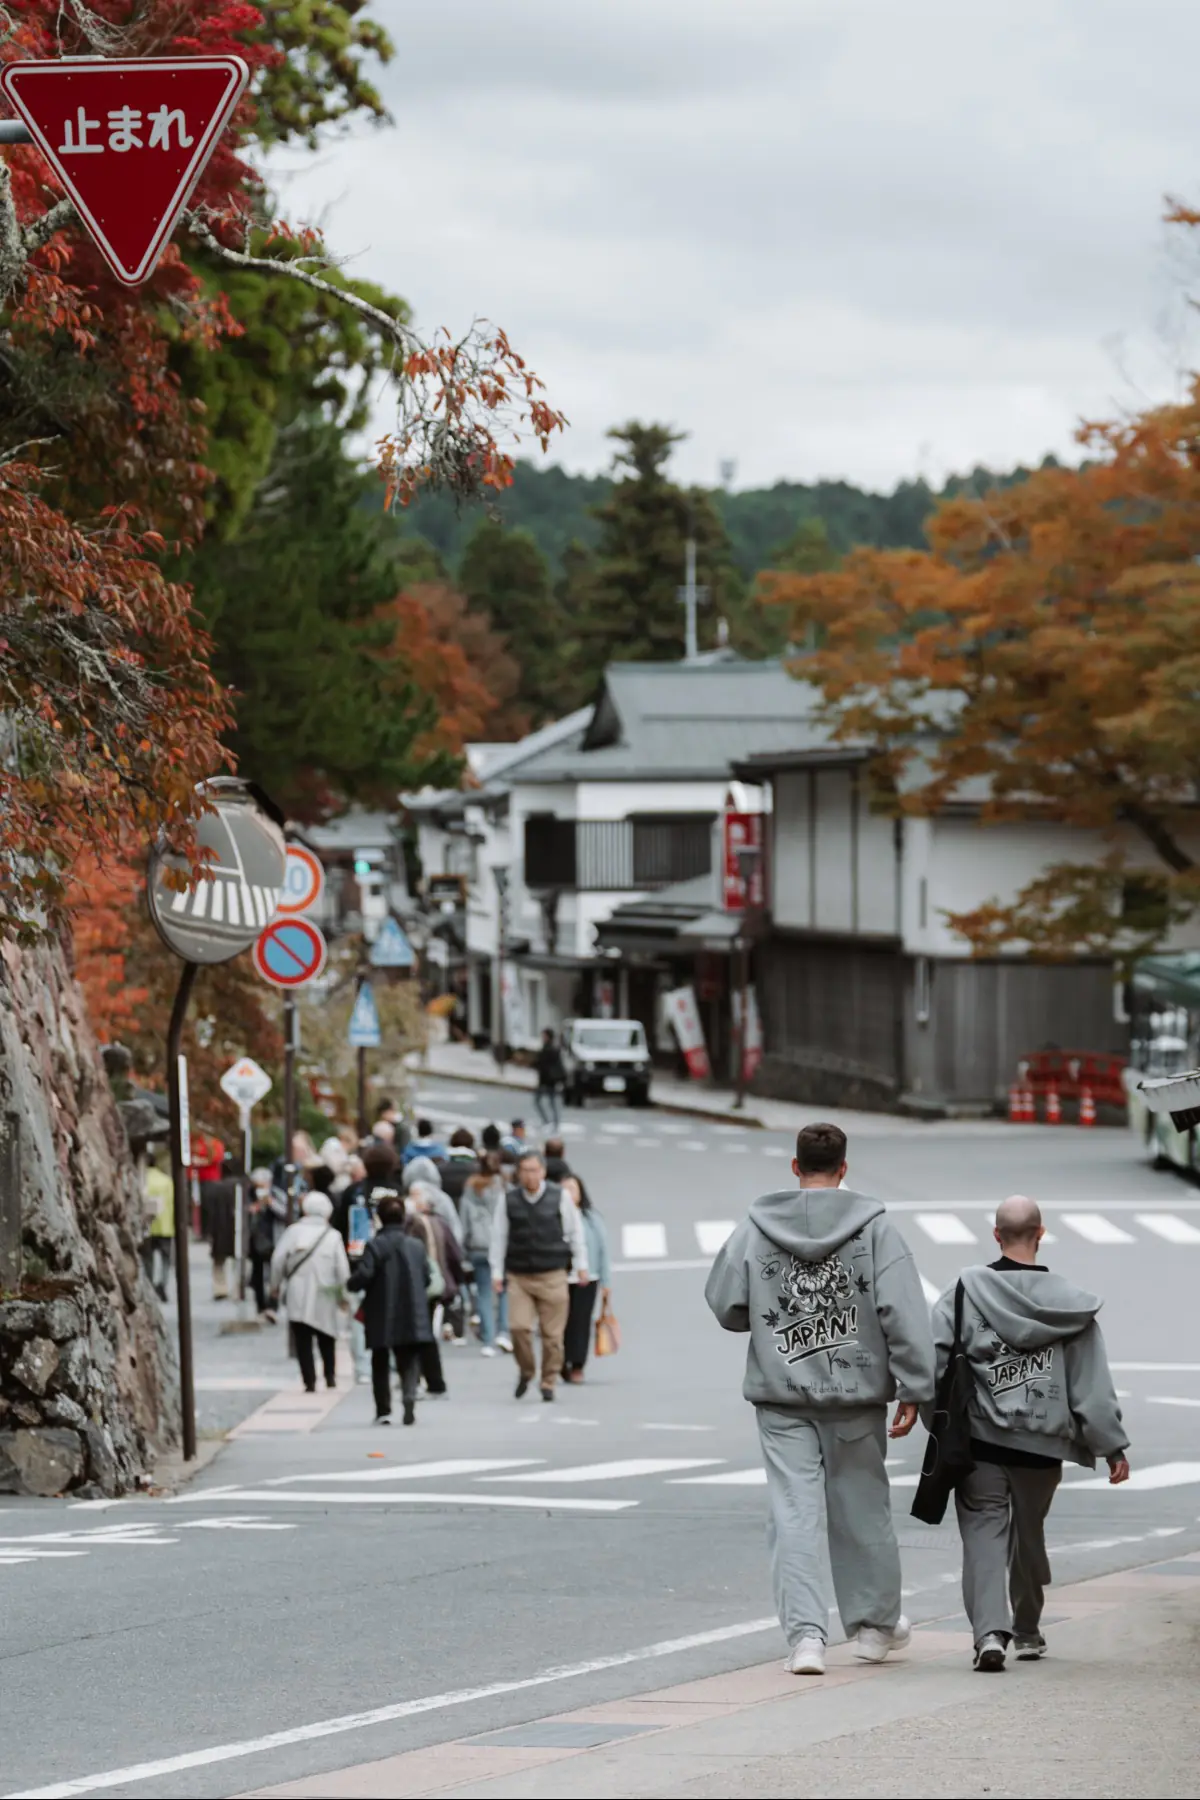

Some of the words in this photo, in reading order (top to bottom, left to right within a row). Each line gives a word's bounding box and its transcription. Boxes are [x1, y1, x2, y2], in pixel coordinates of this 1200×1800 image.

[58, 104, 194, 154] 止まれ
[282, 866, 309, 896] 0
[773, 1304, 858, 1355] JAPAN!
[986, 1347, 1054, 1388] JAPAN!
